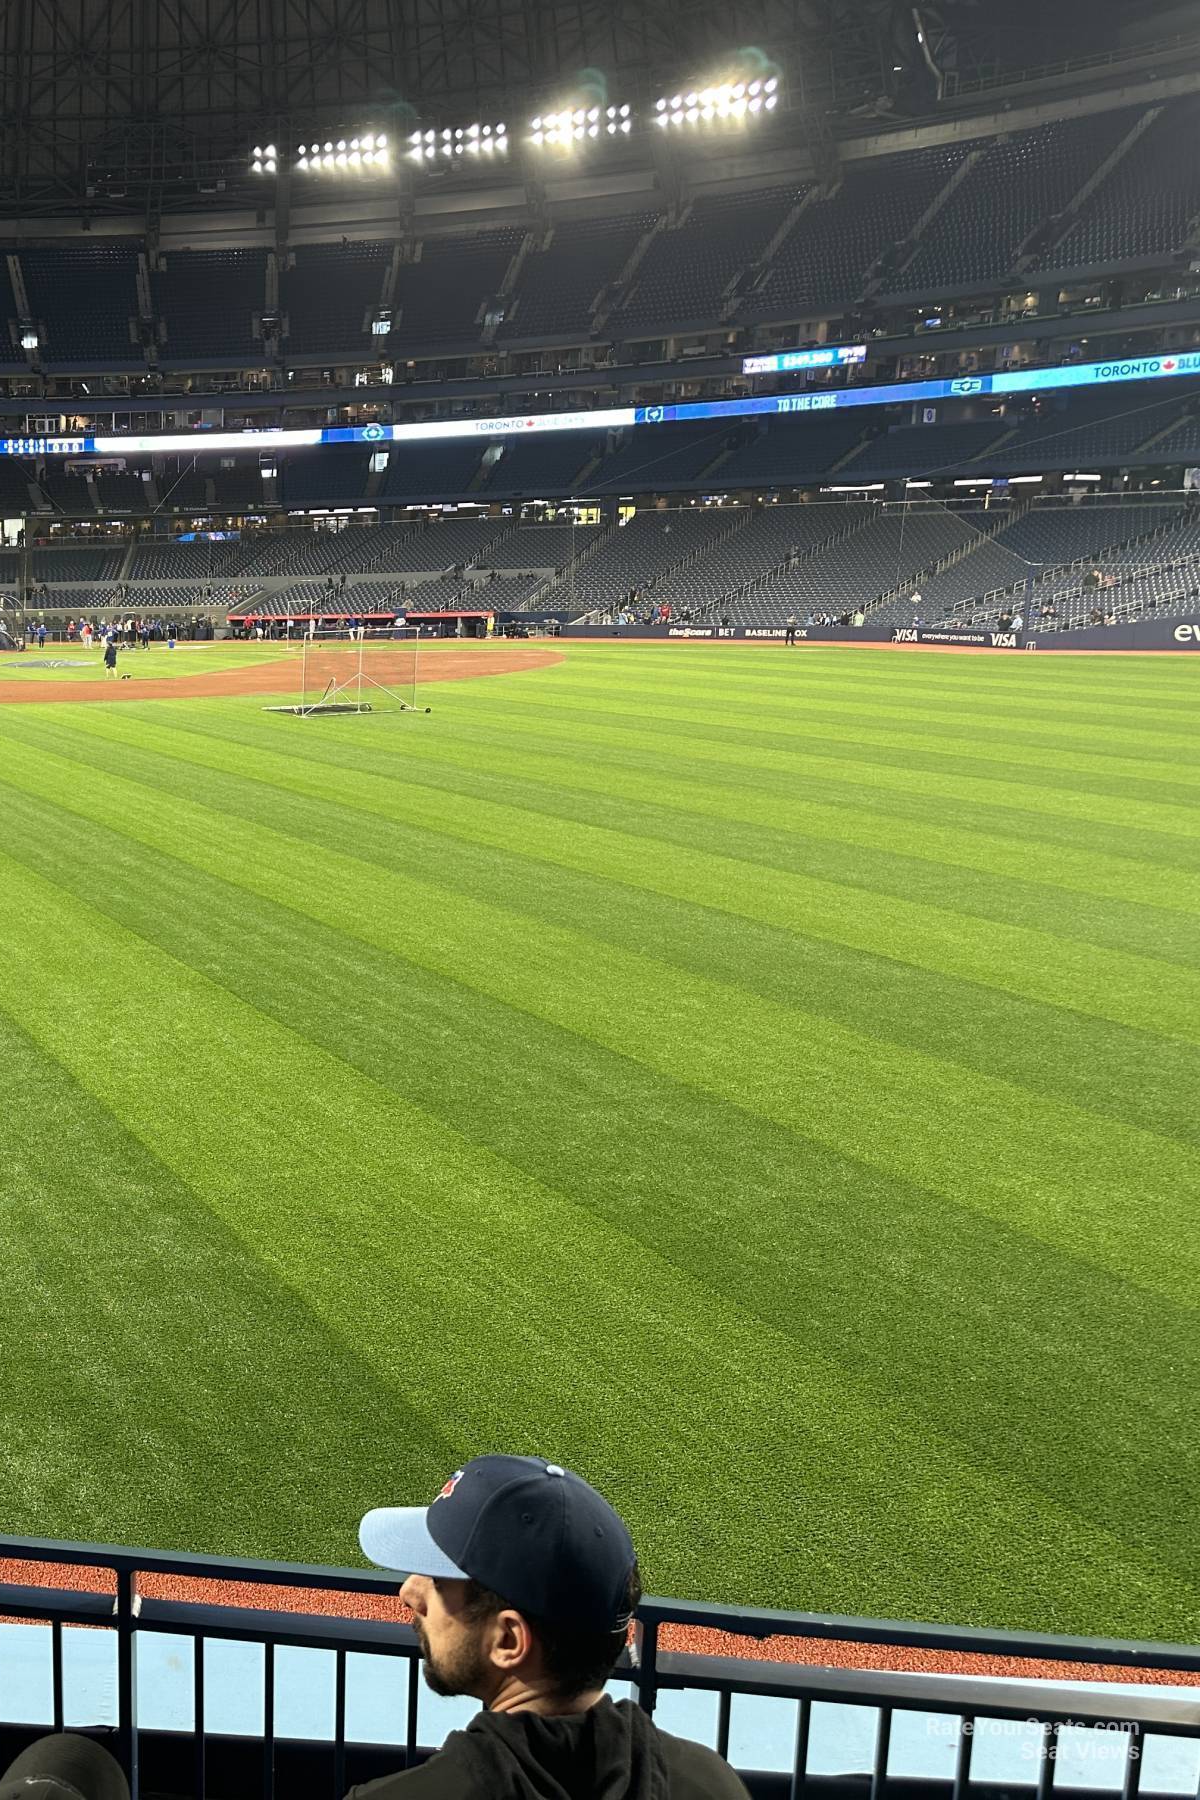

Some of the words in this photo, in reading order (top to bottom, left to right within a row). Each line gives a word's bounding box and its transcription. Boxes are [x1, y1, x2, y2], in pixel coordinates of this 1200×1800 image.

[1094, 361, 1160, 378] TORONTO
[777, 399, 790, 412] TO
[792, 397, 809, 411] THE
[811, 395, 837, 409] CORE
[474, 419, 524, 432] TORONTO
[669, 627, 713, 638] theScore
[718, 628, 736, 637] BET
[745, 629, 787, 638] BASELINE
[895, 628, 919, 641] VISA
[990, 632, 1017, 647] VISA
